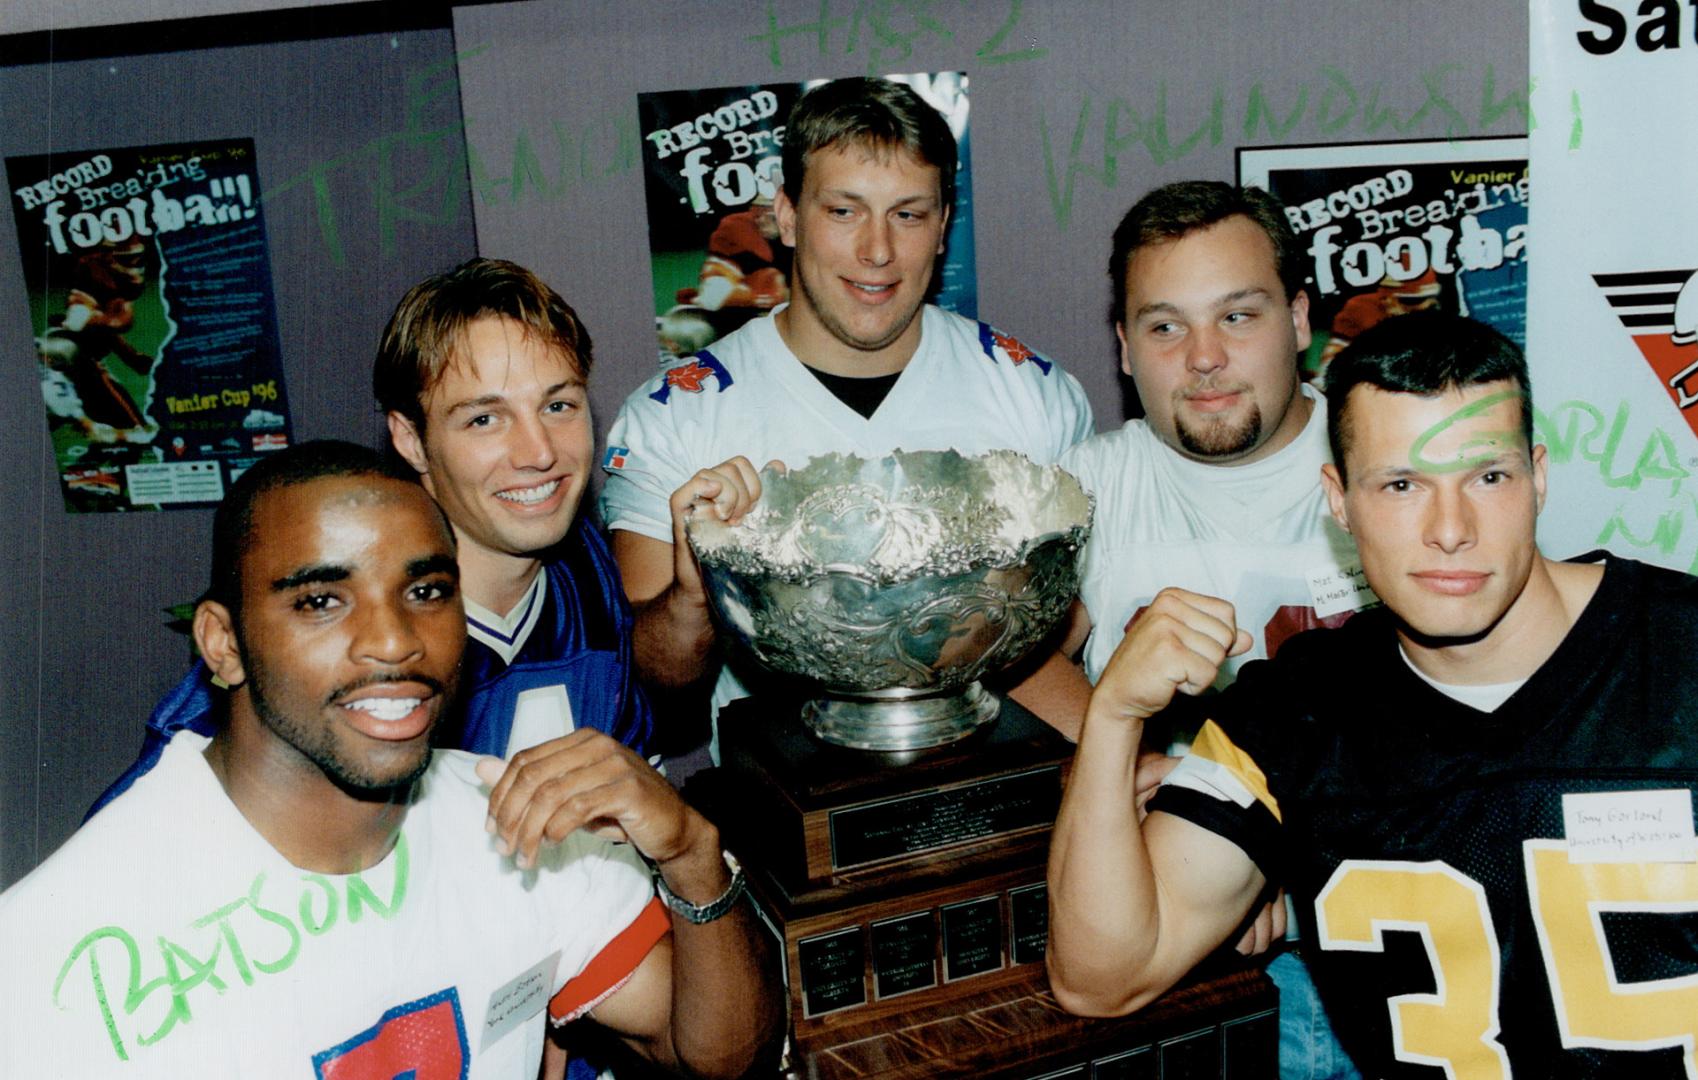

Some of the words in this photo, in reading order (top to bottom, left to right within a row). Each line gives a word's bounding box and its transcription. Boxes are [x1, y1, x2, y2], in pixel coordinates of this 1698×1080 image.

[646, 90, 779, 160] RECORD
[15, 154, 113, 210] RECORD
[1284, 169, 1414, 234] RECORD
[1451, 169, 1516, 185] Vanier
[166, 393, 216, 414] Vanier
[221, 388, 252, 408] Cup
[53, 827, 410, 1061] BATSON
[1315, 838, 1698, 1080] 35
